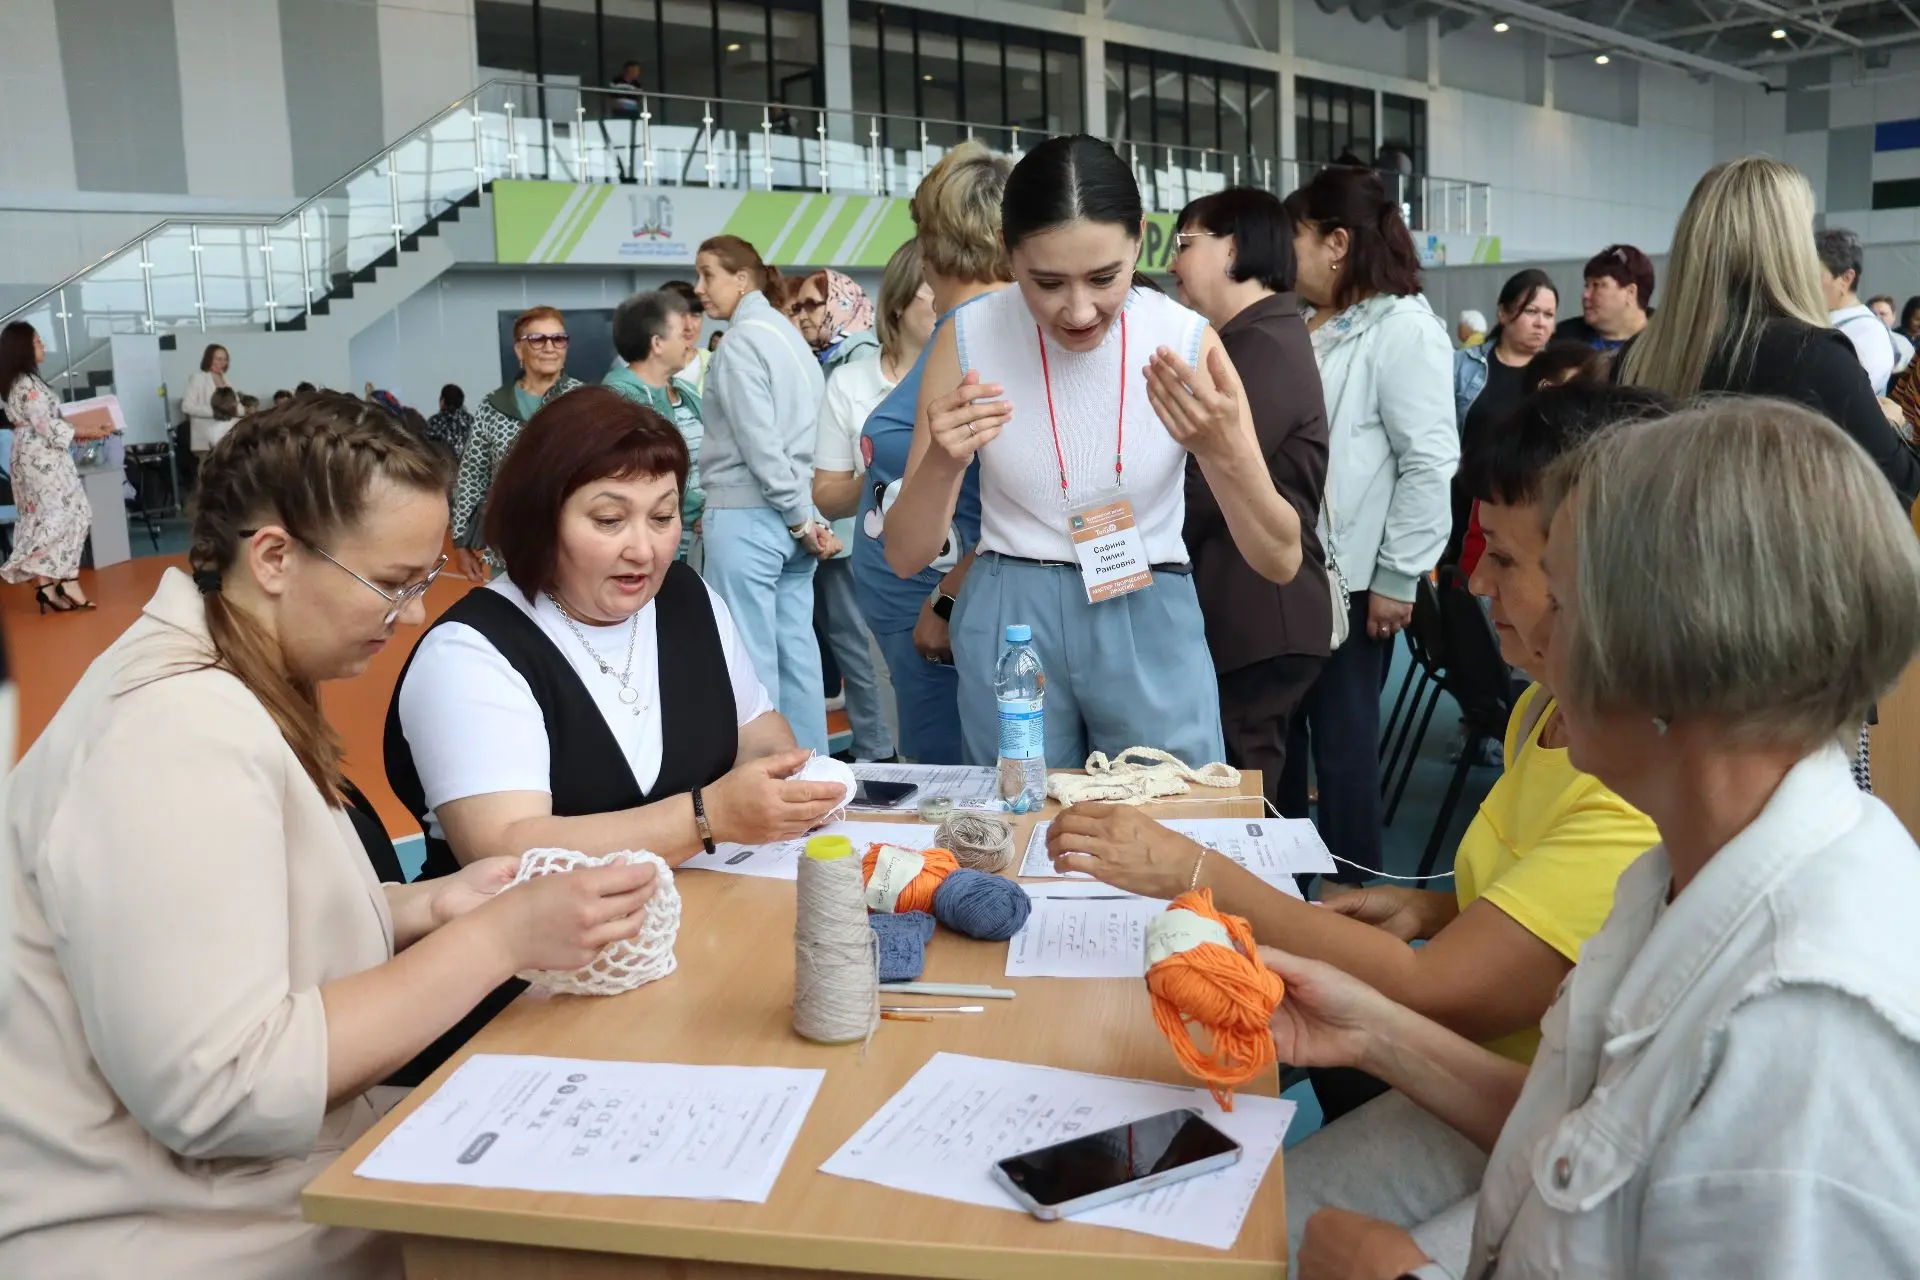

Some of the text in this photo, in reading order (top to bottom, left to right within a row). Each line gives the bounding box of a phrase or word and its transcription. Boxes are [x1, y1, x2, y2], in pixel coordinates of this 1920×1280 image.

[1093, 540, 1126, 553] Сафина
[1100, 551, 1125, 563] Лилия
[1095, 558, 1136, 574] Раисовна
